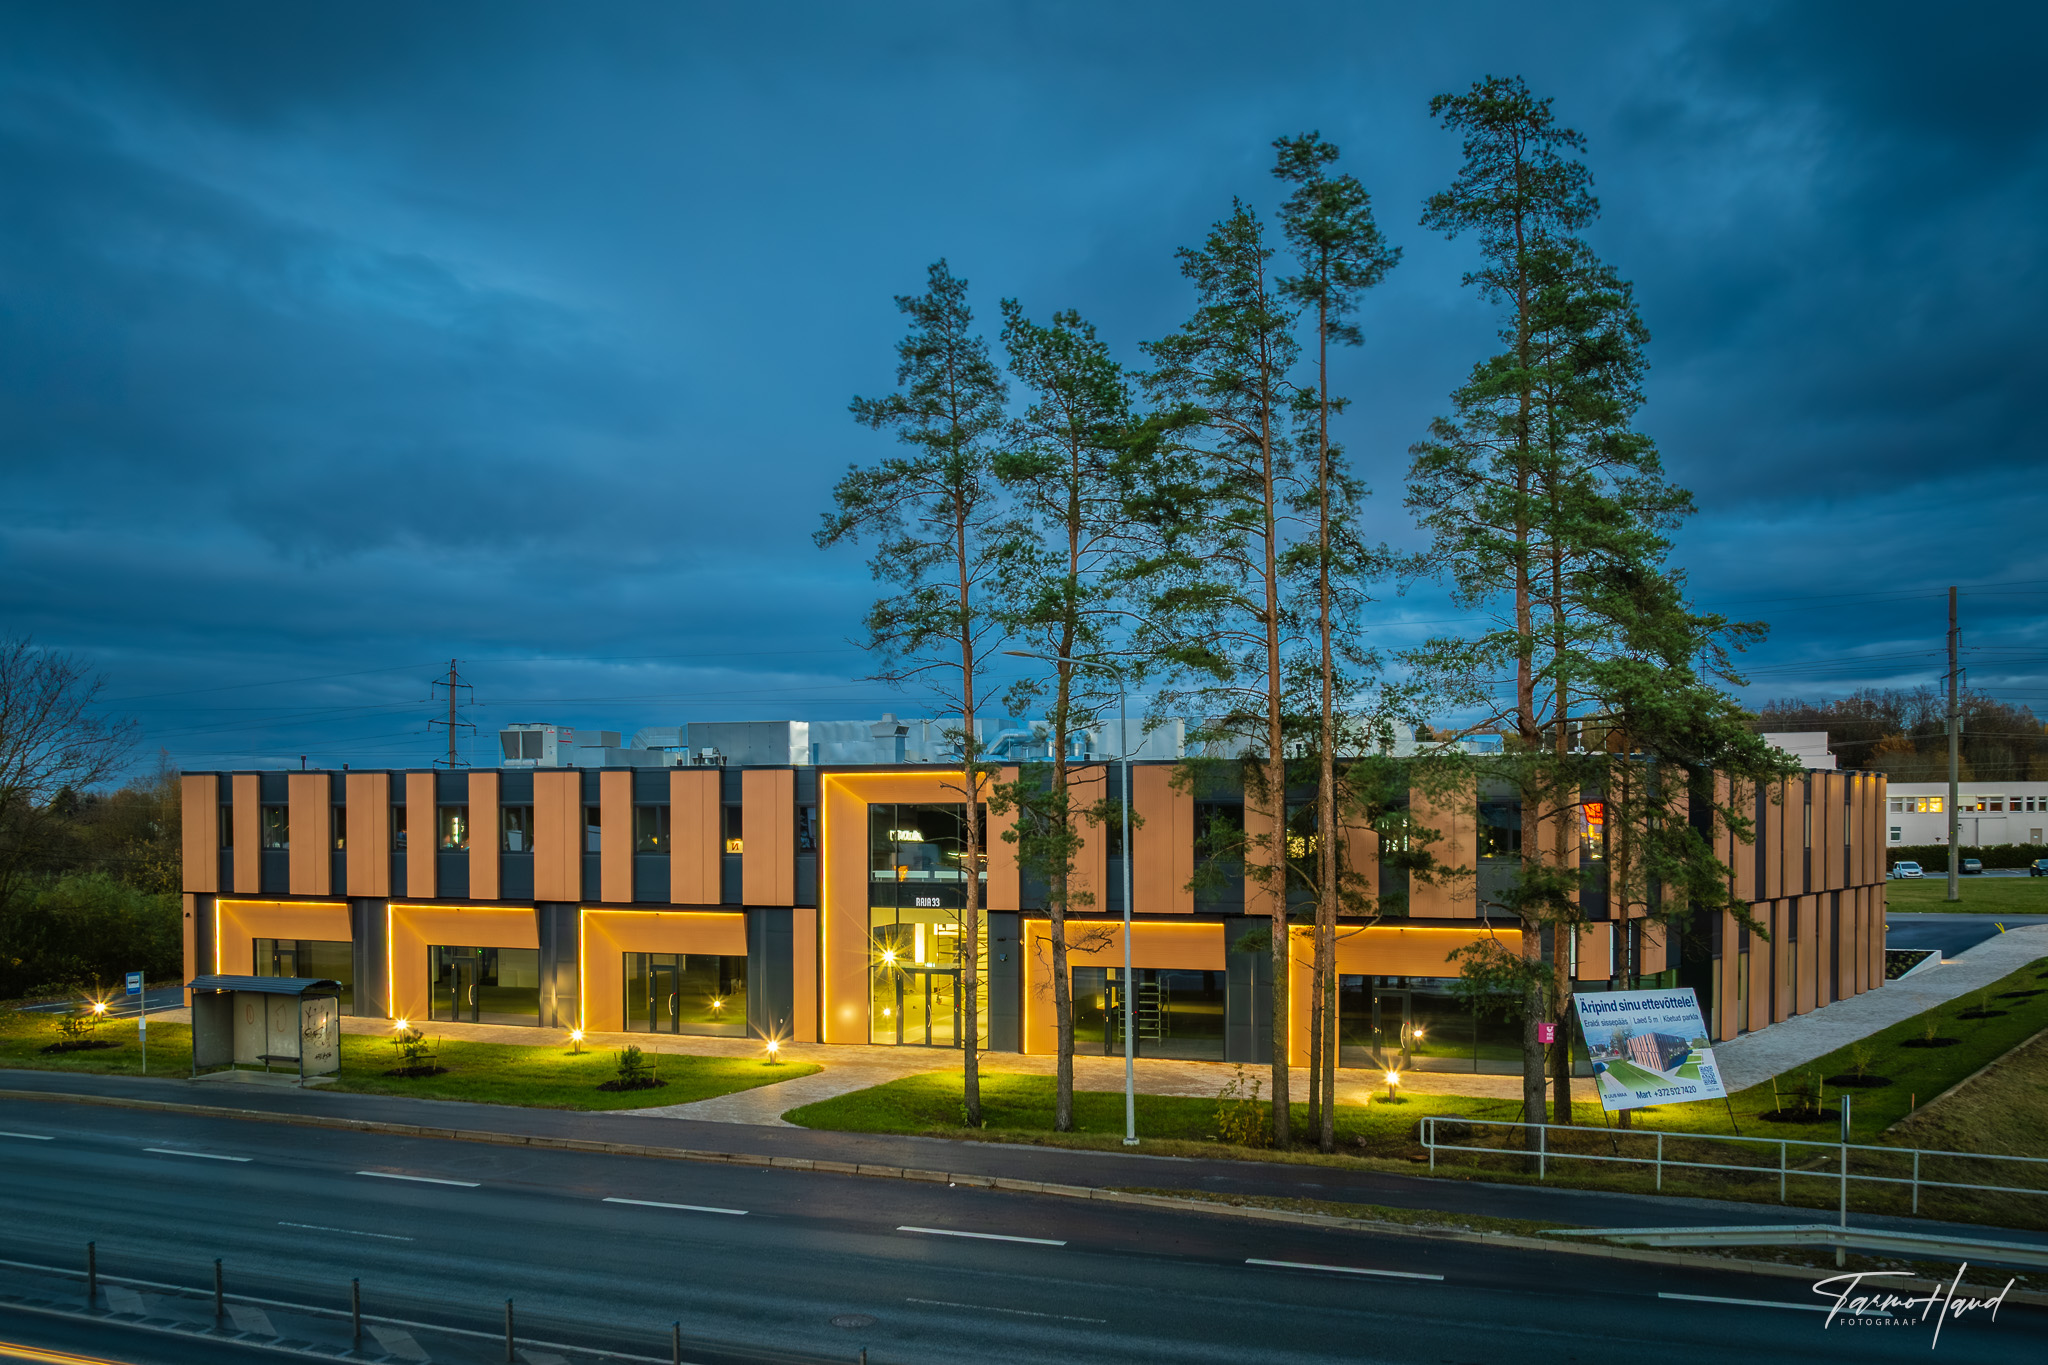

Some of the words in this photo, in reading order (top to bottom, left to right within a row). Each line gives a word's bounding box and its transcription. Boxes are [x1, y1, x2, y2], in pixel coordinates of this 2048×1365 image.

[915, 897, 931, 907] RAJA
[931, 897, 941, 907] 33
[1579, 997, 1617, 1016] Äripind
[1618, 998, 1641, 1012] sinu
[1641, 995, 1695, 1010] ettevõttele!
[1584, 1019, 1600, 1028] Eraldi
[1601, 1018, 1628, 1027] sissepääs
[1648, 1016, 1653, 1024] 5
[1682, 1013, 1699, 1022] parkla
[1635, 1091, 1652, 1099] Mart
[1654, 1088, 1670, 1098] +372
[1670, 1087, 1681, 1096] 512
[1680, 1085, 1697, 1095] 7420
